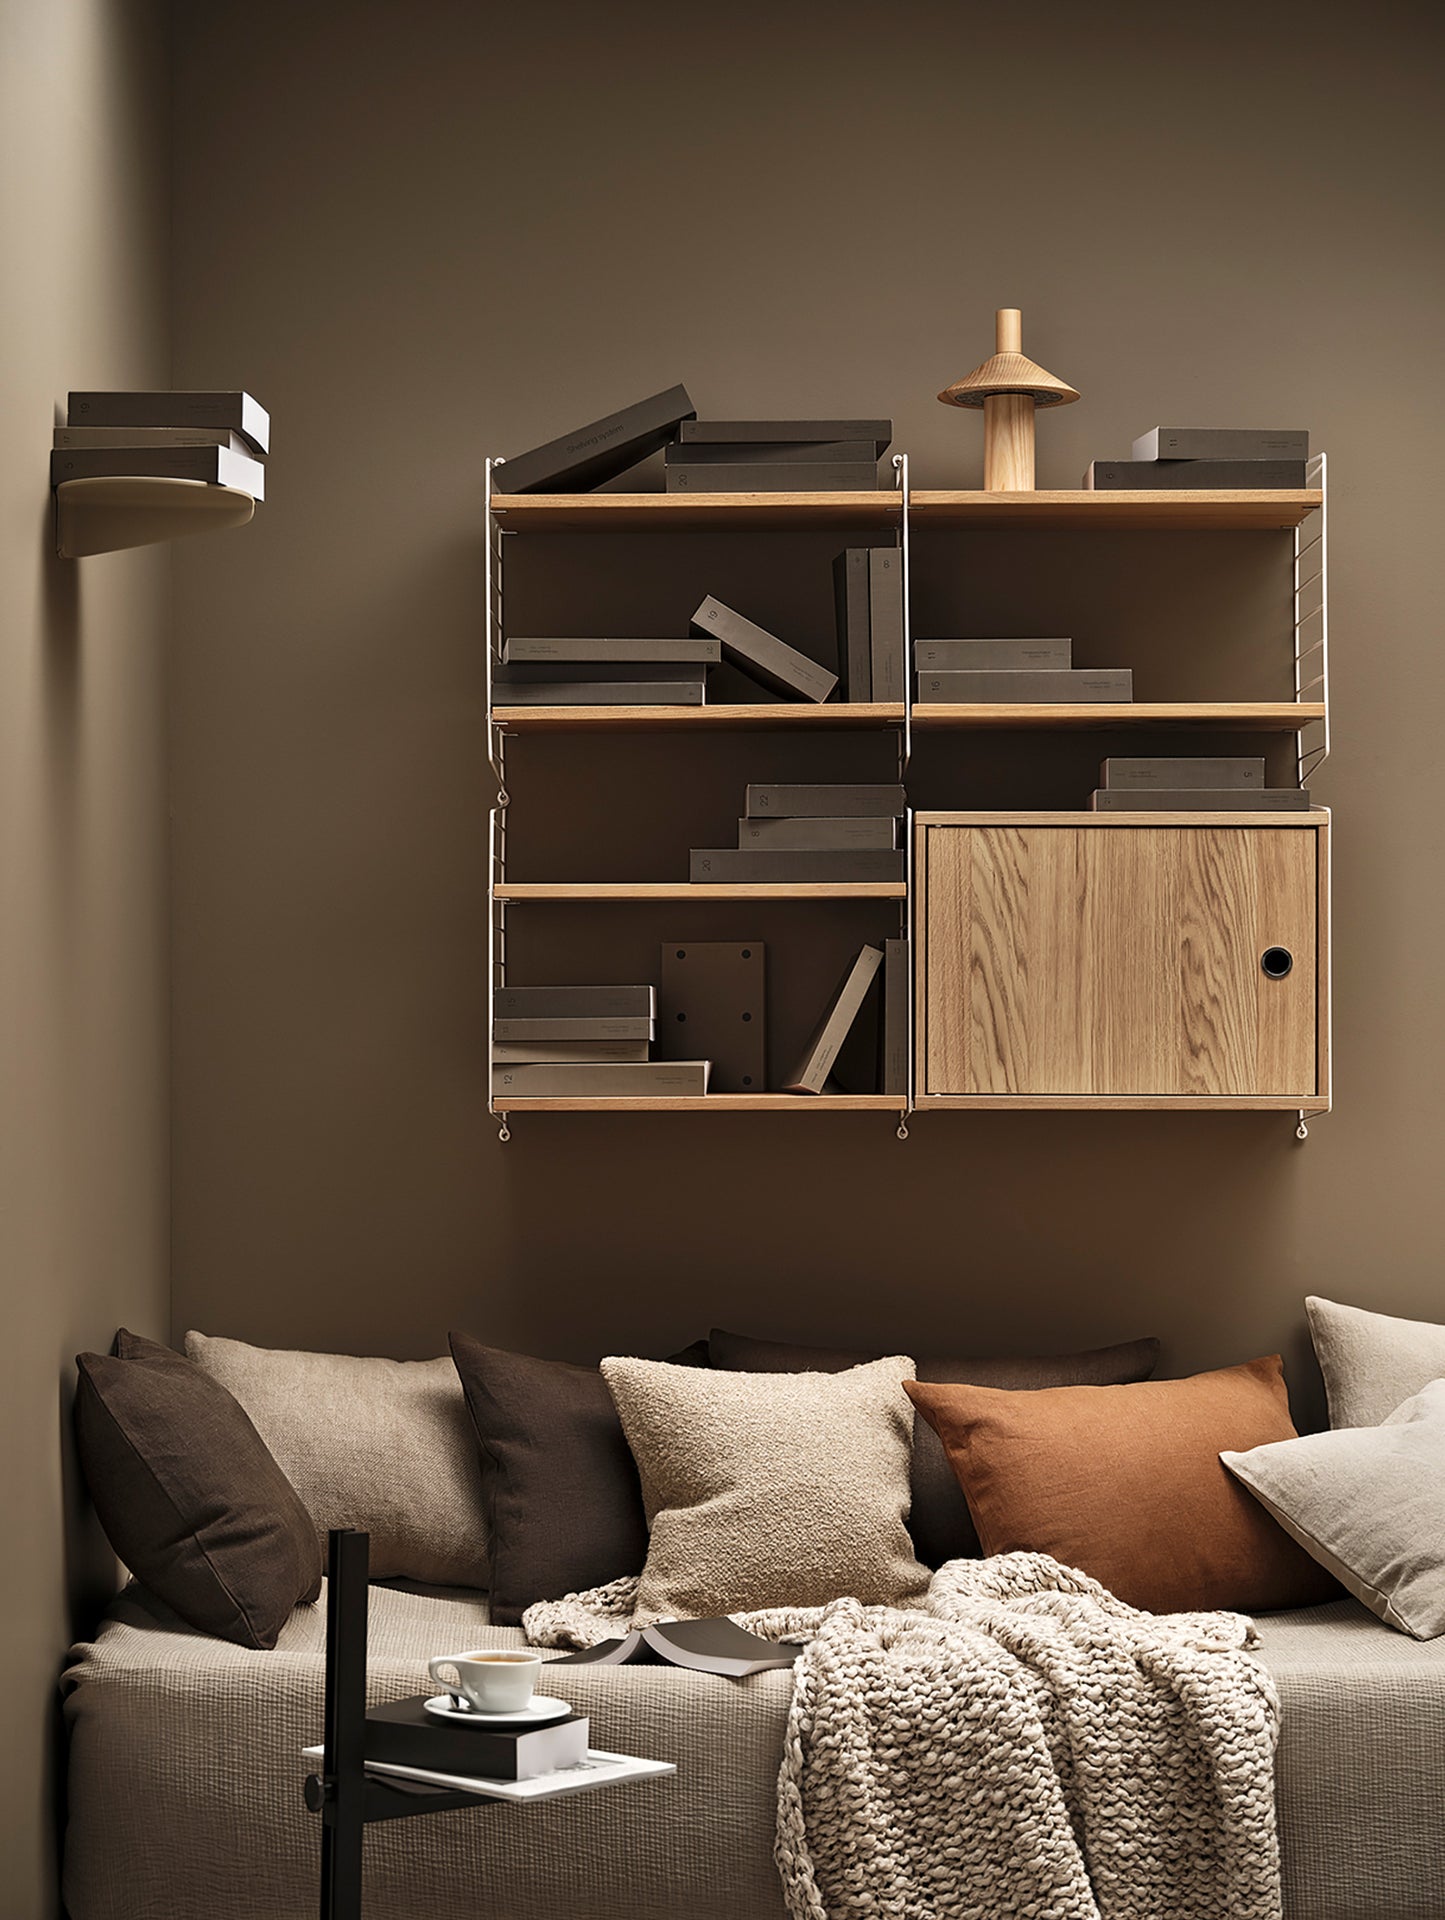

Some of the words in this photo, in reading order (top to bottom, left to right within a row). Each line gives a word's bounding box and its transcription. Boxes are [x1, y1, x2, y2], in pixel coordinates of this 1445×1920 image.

[80, 402, 89, 414] 19
[566, 435, 598, 455] Shelving
[598, 424, 625, 441] system
[678, 474, 688, 486] 20
[883, 560, 890, 568] 8
[708, 610, 719, 620] 19
[931, 681, 940, 691] 16
[760, 794, 769, 806] 22
[702, 859, 711, 872] 20
[504, 1074, 513, 1085] 12
